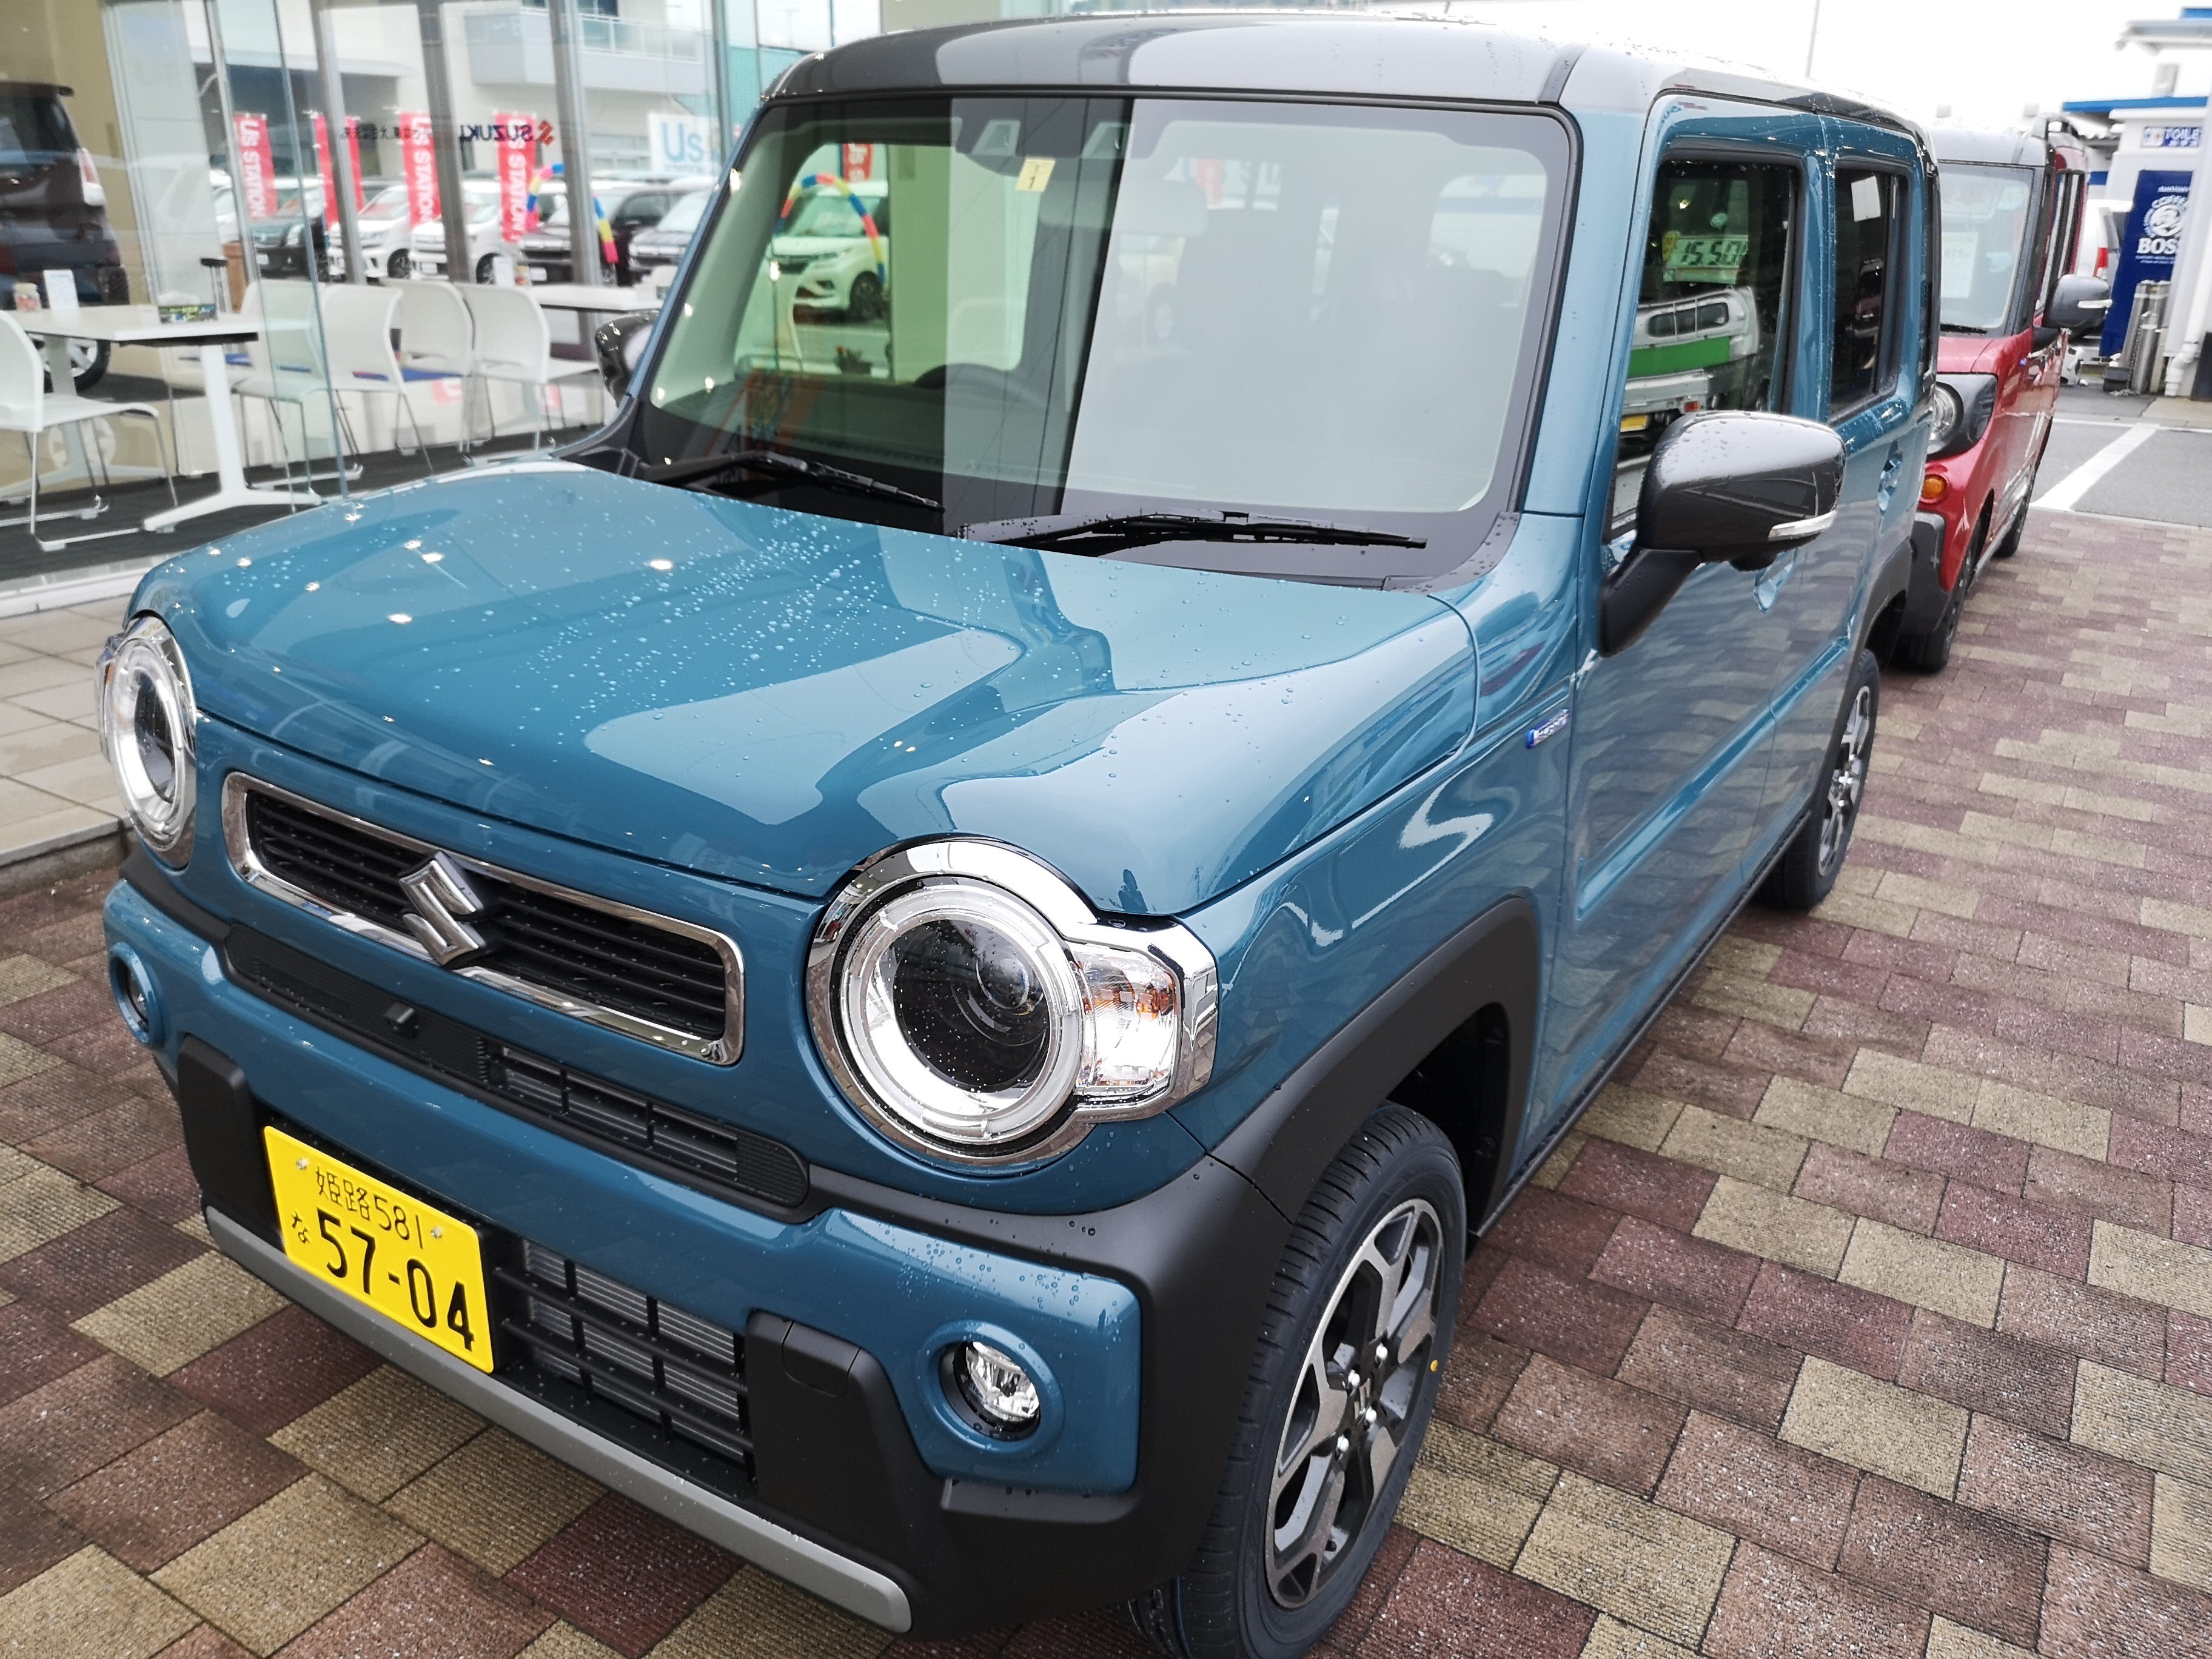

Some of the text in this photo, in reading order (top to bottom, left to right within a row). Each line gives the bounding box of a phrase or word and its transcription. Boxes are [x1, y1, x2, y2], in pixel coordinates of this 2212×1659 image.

[2136, 238, 2178, 255] BOS
[292, 1207, 475, 1352] な 57-04
